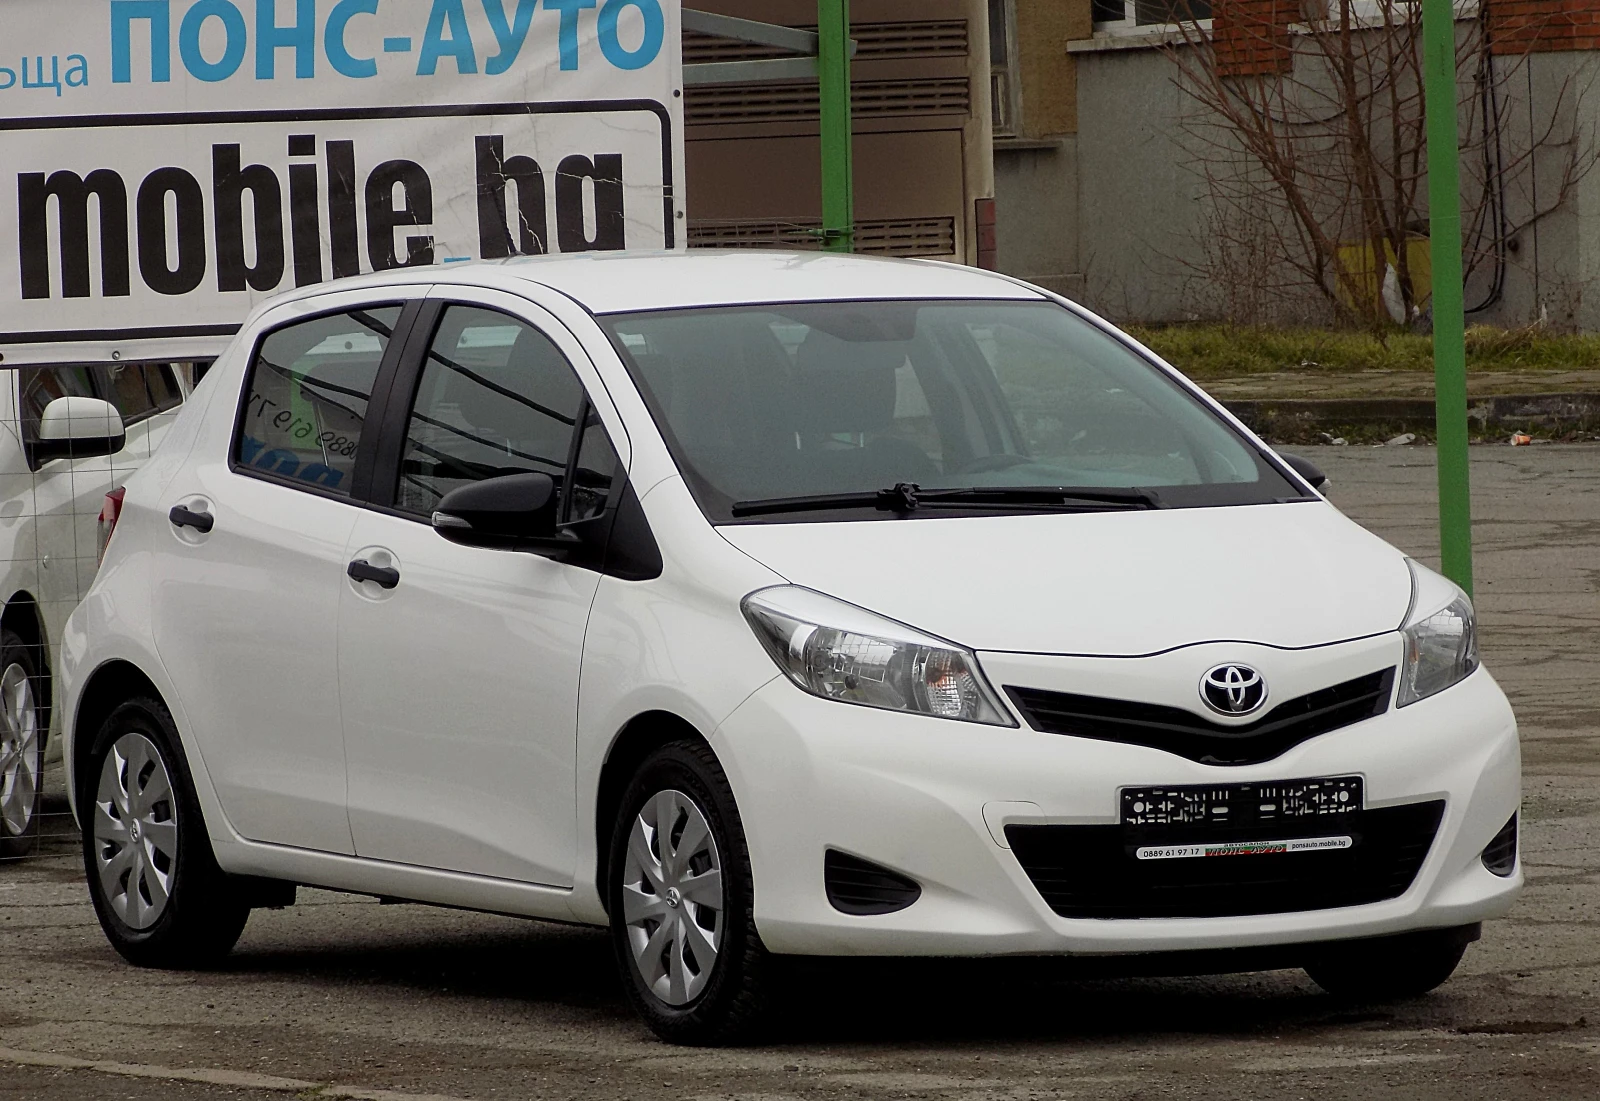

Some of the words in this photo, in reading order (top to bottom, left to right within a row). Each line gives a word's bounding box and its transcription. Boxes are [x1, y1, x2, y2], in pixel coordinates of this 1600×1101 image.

[110, 0, 665, 84] ПОНС-АУТО
[1291, 839, 1346, 850] ponsauto.mobile.bg
[1143, 850, 1164, 858] 0889
[1165, 849, 1175, 857] 61
[1177, 848, 1188, 856] 97
